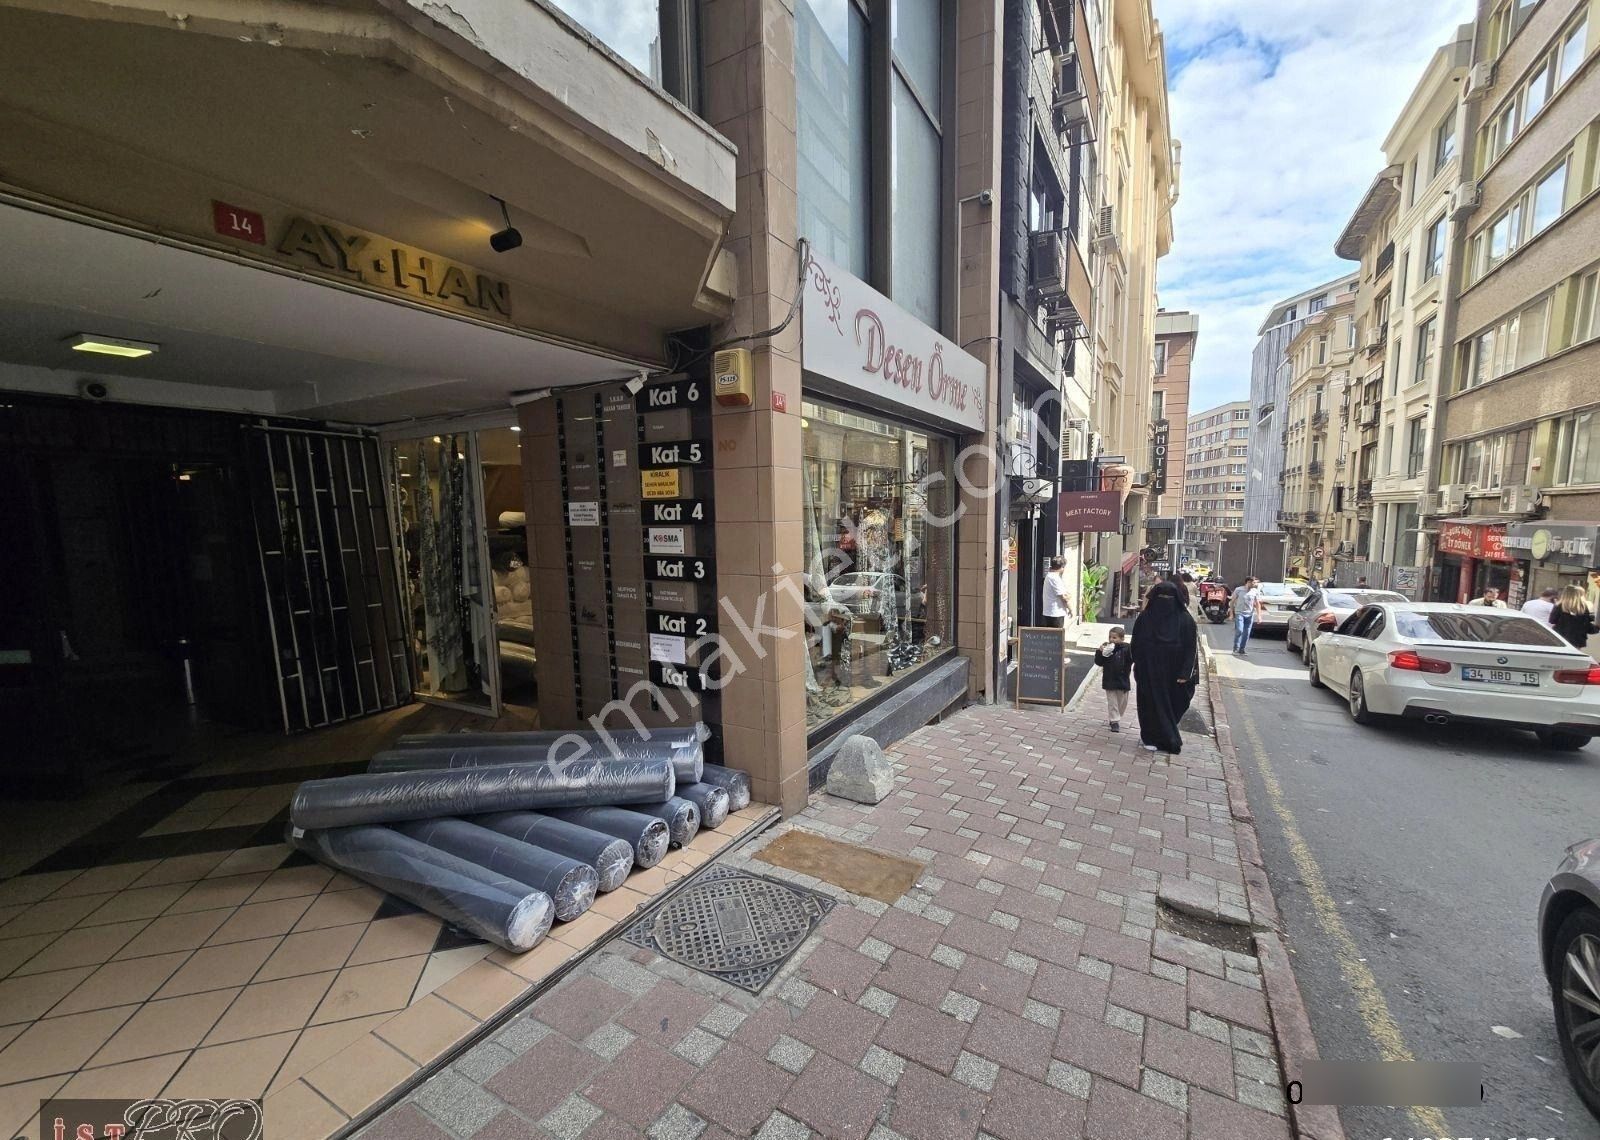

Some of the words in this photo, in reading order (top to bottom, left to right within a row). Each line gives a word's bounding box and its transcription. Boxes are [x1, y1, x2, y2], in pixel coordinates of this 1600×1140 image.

[229, 213, 253, 234] 14
[854, 308, 923, 395] Desen
[927, 341, 968, 412] Örme
[649, 386, 677, 407] Kat
[687, 382, 699, 402] 6
[651, 445, 680, 464] Kat
[689, 443, 702, 462] 5
[718, 440, 737, 451] NO
[1156, 435, 1166, 489] HOTEL
[654, 503, 682, 521] Kat
[691, 502, 704, 520] 4
[1065, 508, 1082, 518] MEAT
[1083, 507, 1112, 517] FACTORY
[656, 560, 684, 578] Kat
[694, 561, 705, 579] 3
[659, 614, 687, 633] Kat
[695, 618, 707, 636] 2
[661, 667, 689, 687] Kat
[698, 672, 707, 690] 1
[1470, 669, 1483, 678] 34
[1490, 670, 1512, 681] HBD
[1522, 673, 1536, 683] 15
